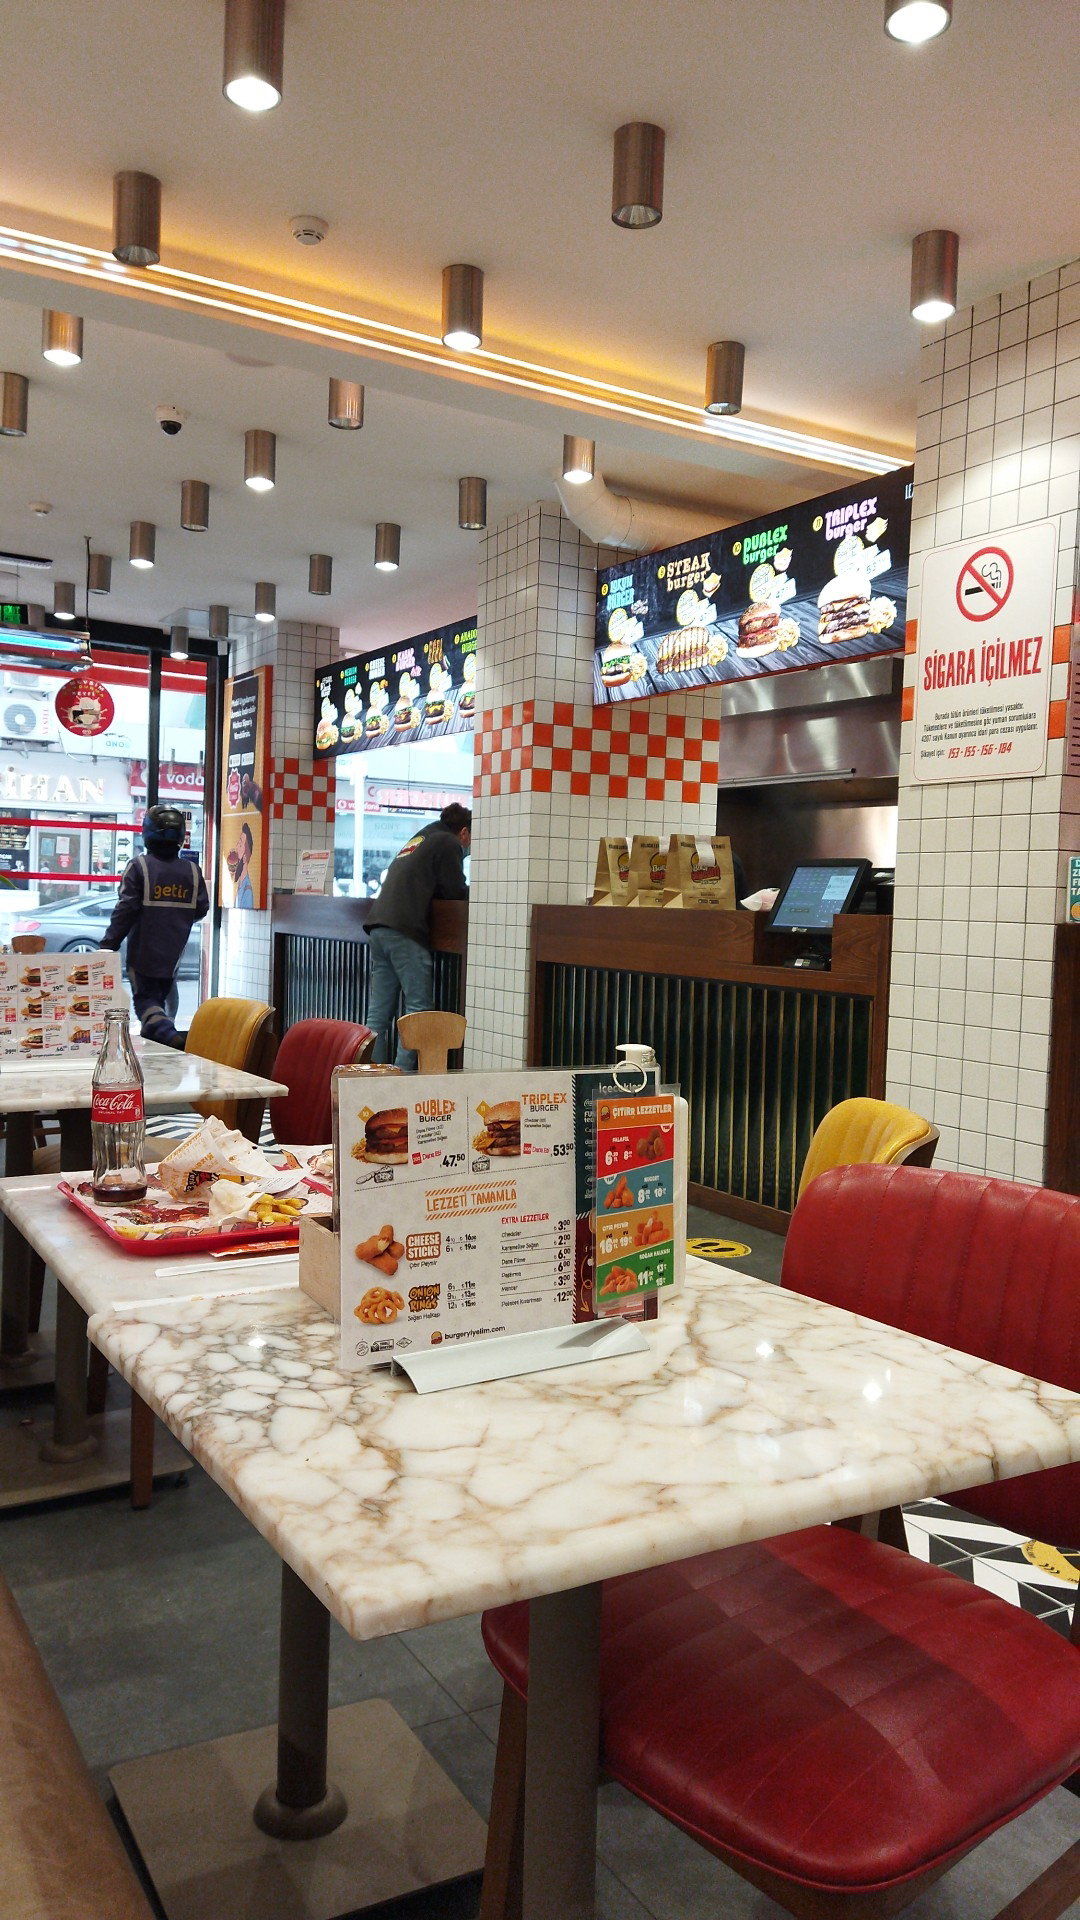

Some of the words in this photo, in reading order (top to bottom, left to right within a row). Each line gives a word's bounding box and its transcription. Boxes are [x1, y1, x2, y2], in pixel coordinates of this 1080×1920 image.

[825, 496, 878, 528] TRIPLEX
[825, 518, 868, 541] burger
[743, 524, 788, 553] DUBLEX
[743, 543, 779, 565] burger
[666, 552, 712, 578] STEAK
[666, 570, 707, 592] burger
[606, 588, 635, 611] BURGER
[923, 649, 976, 691] SİGARA
[980, 636, 1043, 687] İÇİLMEZ
[935, 712, 950, 721] Burada
[980, 704, 1004, 715] tüketilmesi
[983, 718, 992, 727] göz
[992, 716, 1007, 724] yuman
[1008, 711, 1036, 721] sorumlulara
[944, 731, 958, 740] Kanun
[988, 727, 999, 737] para
[948, 747, 961, 759] 153
[964, 745, 977, 757] 155
[981, 743, 994, 756] 156
[998, 741, 1013, 754] 184
[154, 883, 189, 900] getir
[93, 1093, 136, 1111] Coca-Cola
[521, 1093, 568, 1105] TRIPLEX
[414, 1099, 456, 1116] DUBLEX
[530, 1104, 559, 1112] BURGER
[636, 1104, 673, 1115] LEZZETLER
[419, 1114, 452, 1123] BURGER
[553, 1143, 574, 1156] 53.50
[442, 1153, 466, 1168] 47.50
[427, 1192, 468, 1212] LEZZETİ
[472, 1188, 517, 1205] TAMAMLA
[501, 1216, 519, 1224] EXTRA
[520, 1213, 550, 1222] LEZZETLER
[557, 1219, 571, 1231] 3.00
[408, 1233, 440, 1247] CHEESE
[557, 1234, 571, 1246] 2.00
[408, 1246, 440, 1259] STICKS
[557, 1248, 571, 1260] 6.00
[557, 1274, 571, 1286] 3.00
[409, 1284, 441, 1300] ONION
[556, 1289, 574, 1303] 12.00
[409, 1298, 438, 1312] RINGS
[445, 1325, 506, 1341] burgeryiyelim.com
